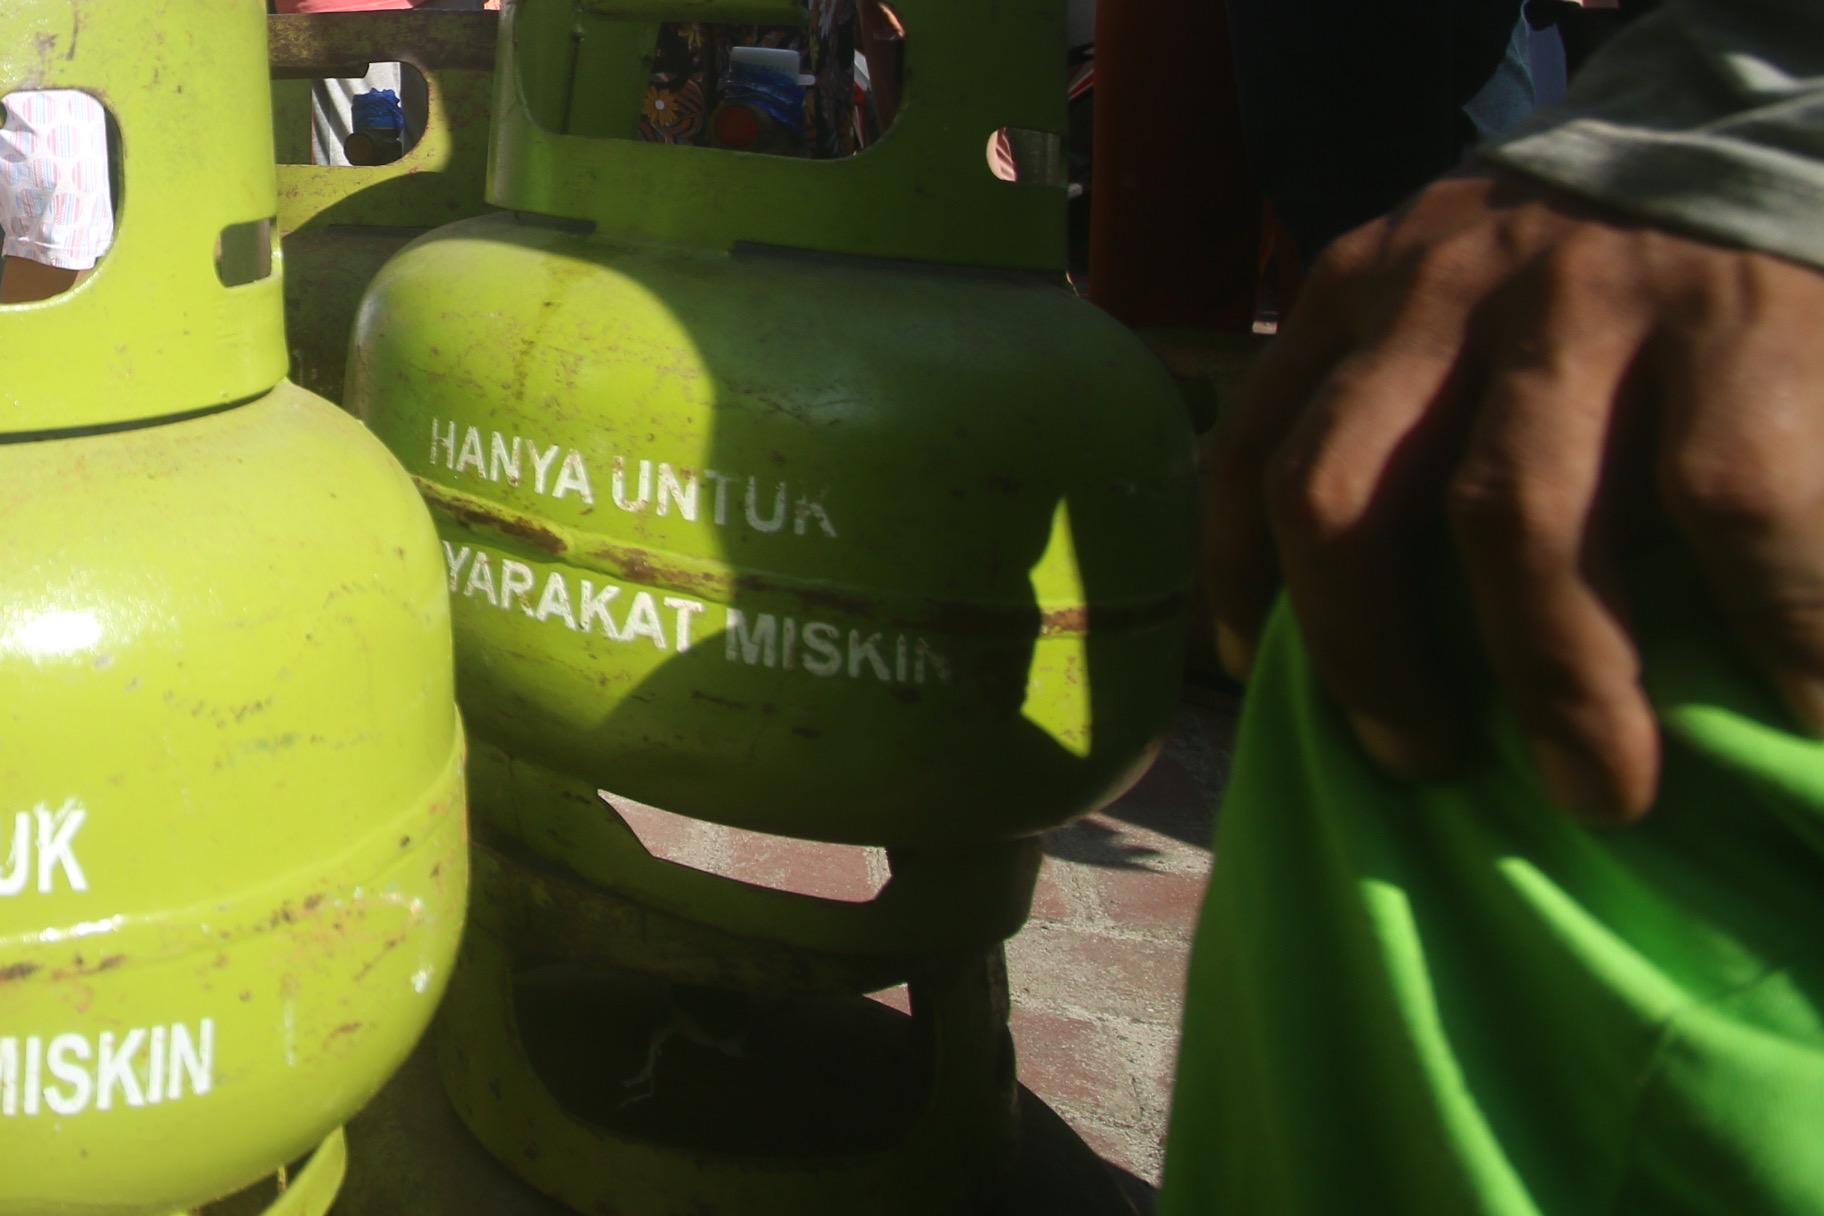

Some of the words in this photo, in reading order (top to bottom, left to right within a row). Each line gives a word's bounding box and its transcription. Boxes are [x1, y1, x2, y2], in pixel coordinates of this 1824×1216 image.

[430, 417, 594, 505] HANYA
[611, 455, 838, 538] UNTUK
[442, 539, 704, 654] YARAKAT
[725, 606, 952, 684] MISKIN
